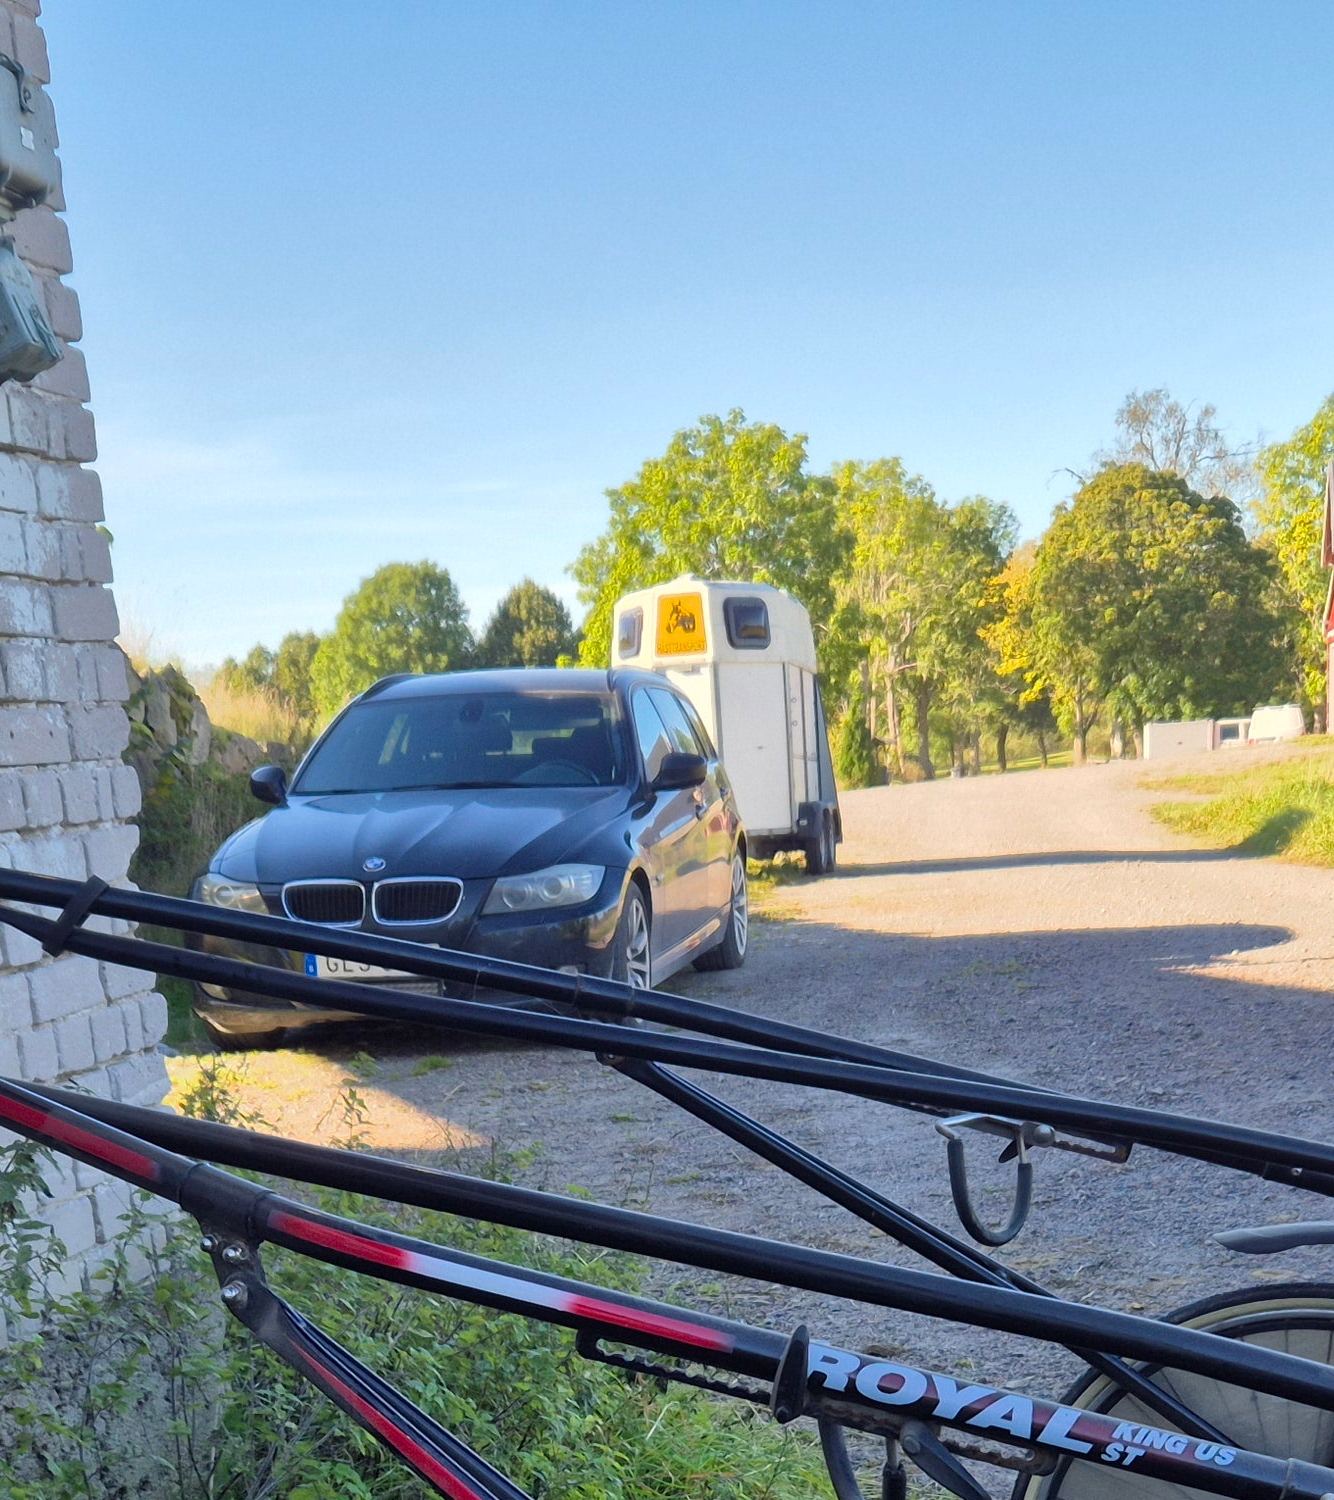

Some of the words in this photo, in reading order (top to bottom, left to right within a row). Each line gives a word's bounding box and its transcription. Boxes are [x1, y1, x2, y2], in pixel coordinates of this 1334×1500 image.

[807, 1342, 1094, 1454] ROYAL
[1100, 1442, 1146, 1466] ST
[1111, 1422, 1189, 1455] KING
[1194, 1442, 1237, 1467] US
